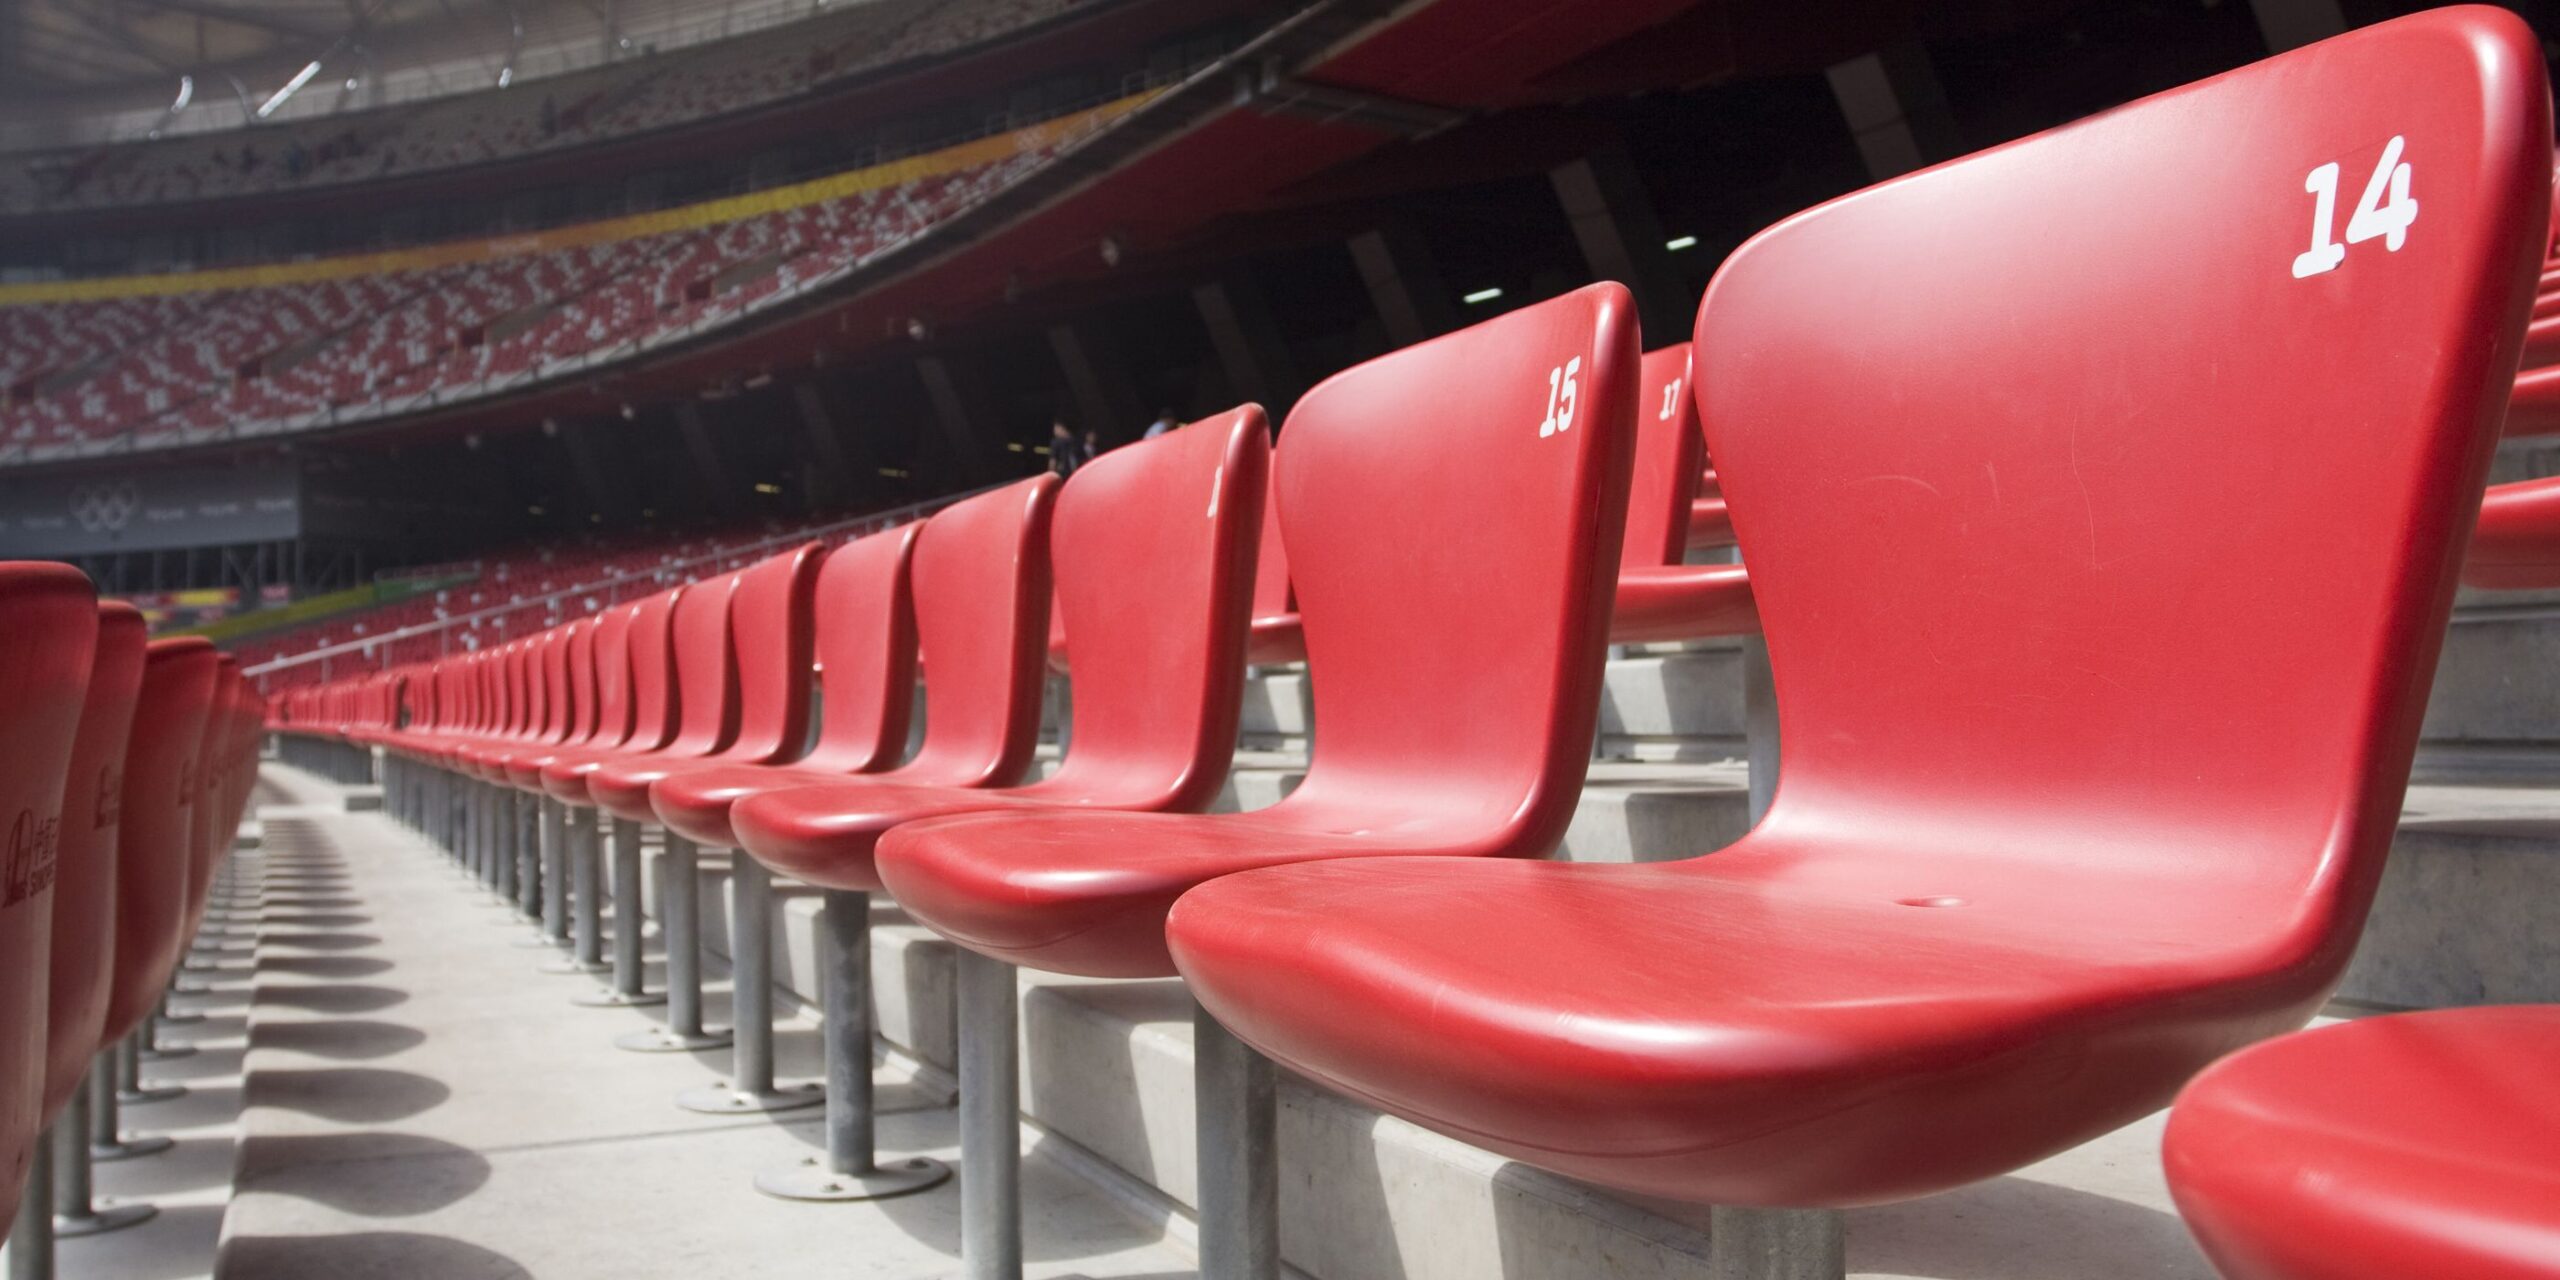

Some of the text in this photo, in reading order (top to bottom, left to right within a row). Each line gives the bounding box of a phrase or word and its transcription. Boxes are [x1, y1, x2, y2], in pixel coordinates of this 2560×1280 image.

[2292, 135, 2418, 279] 14
[1539, 355, 1581, 438] 15
[1659, 378, 1682, 421] 17
[1207, 465, 1223, 518] 1
